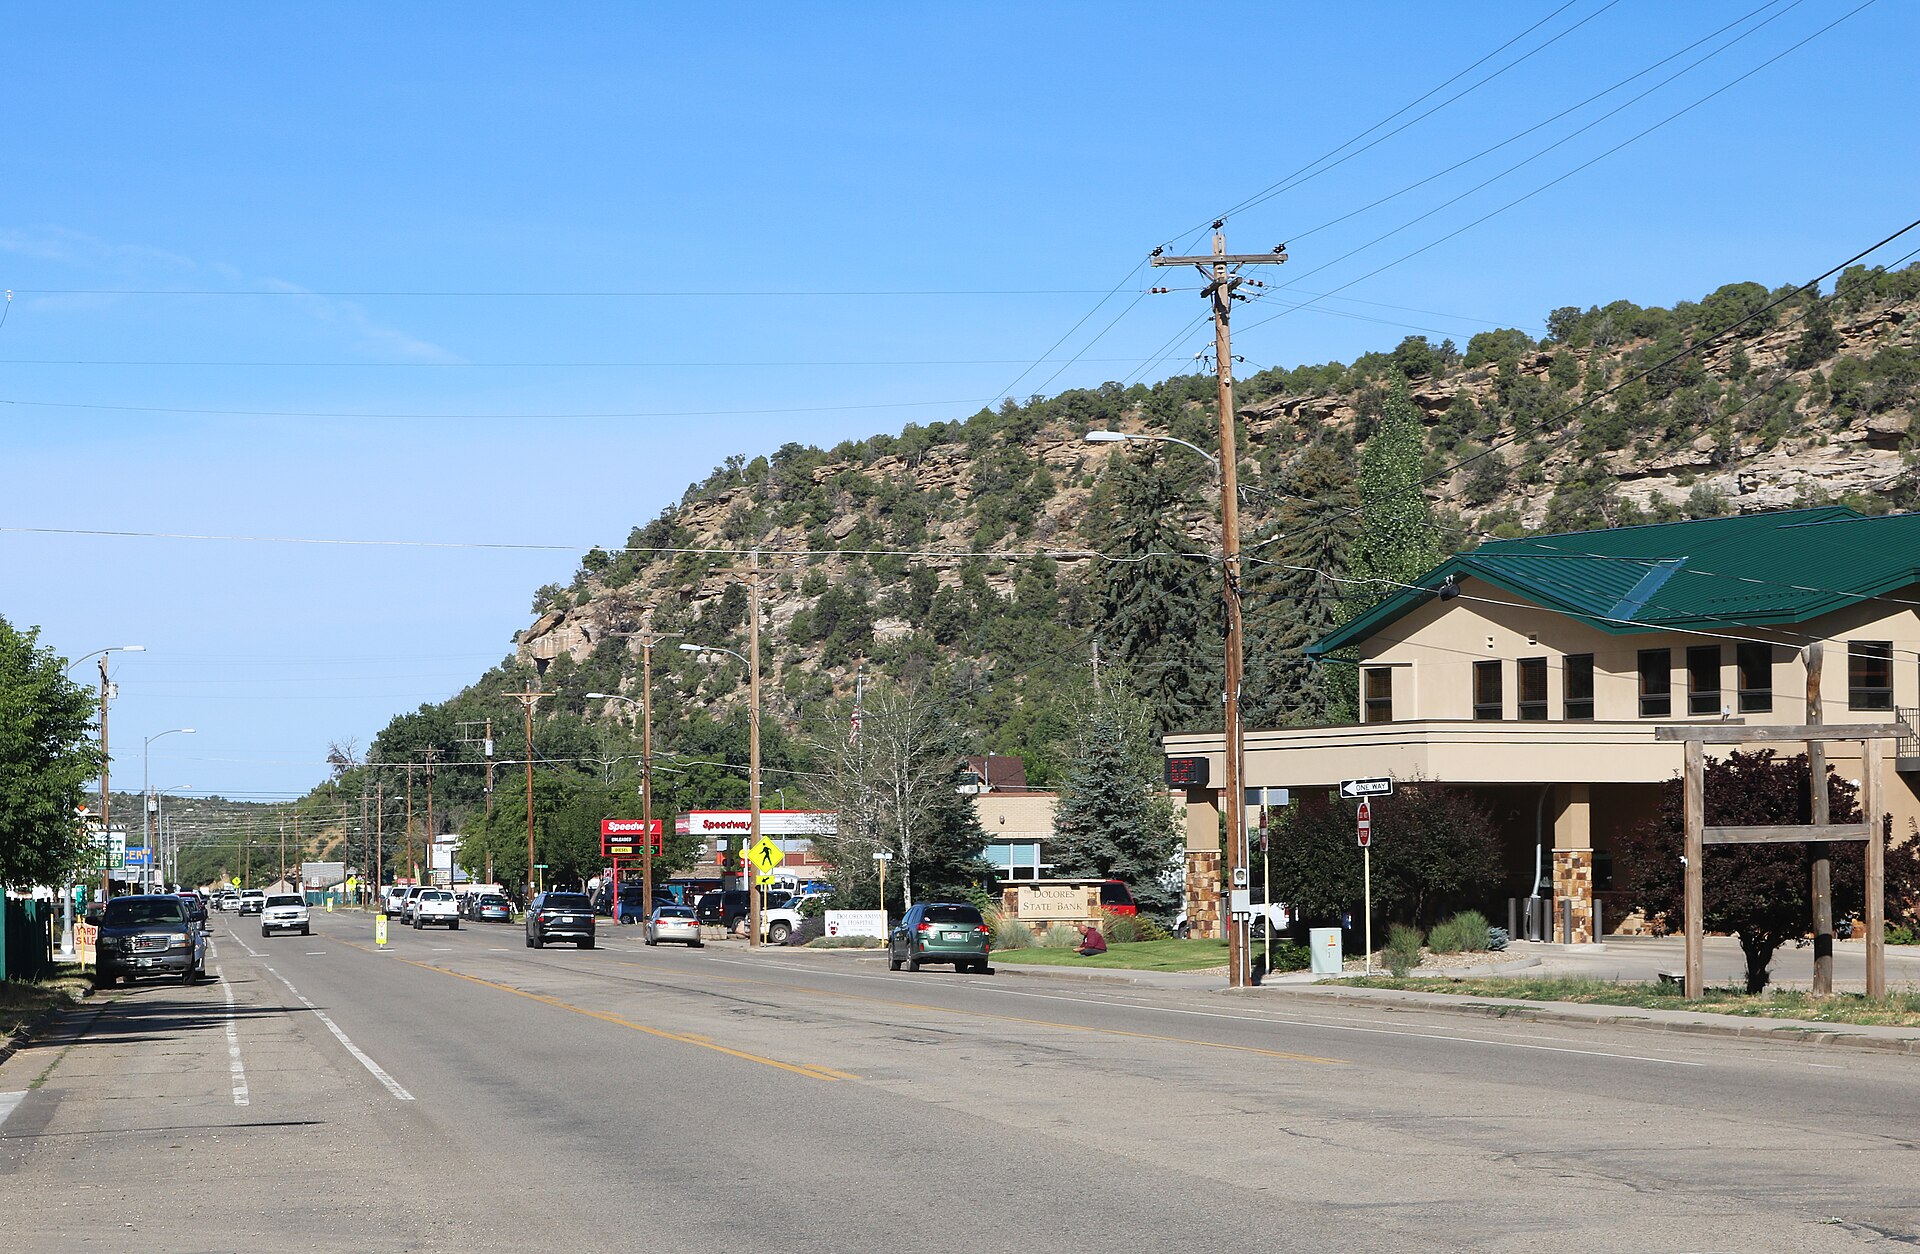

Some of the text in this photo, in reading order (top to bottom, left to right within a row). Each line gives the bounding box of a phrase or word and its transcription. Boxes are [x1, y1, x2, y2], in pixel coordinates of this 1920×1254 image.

[607, 821, 656, 832] Speedwy
[702, 819, 752, 831] Speedway
[1034, 890, 1075, 898] DOLORES
[1023, 902, 1083, 911] STATE BANK
[75, 926, 97, 936] YARD
[75, 936, 97, 946] SALE
